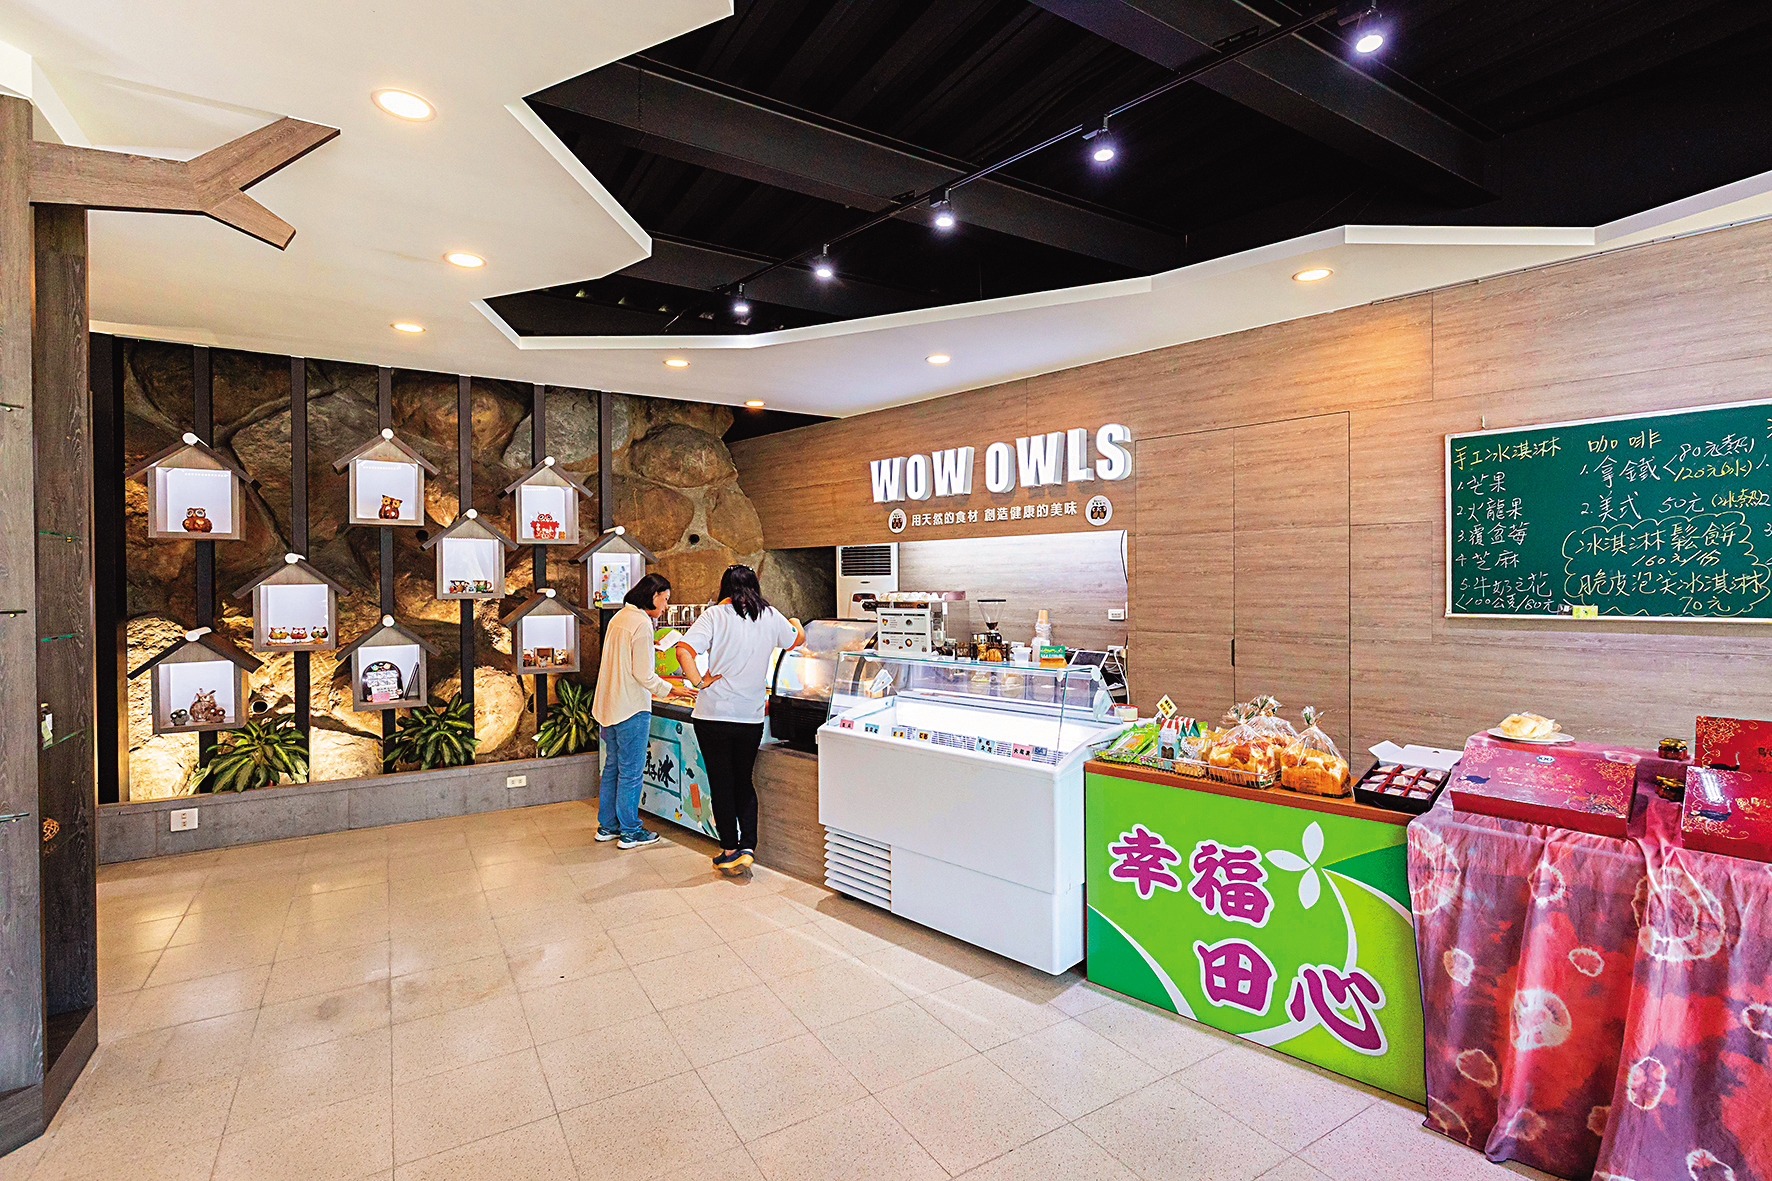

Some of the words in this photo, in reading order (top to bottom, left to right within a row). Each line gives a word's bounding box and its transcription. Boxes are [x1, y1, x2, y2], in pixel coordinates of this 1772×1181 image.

[870, 446, 974, 503] WOW
[985, 423, 1132, 493] OWLS
[1454, 436, 1561, 470] 手工冰淇淋
[911, 510, 978, 527] 用天然的食材
[984, 501, 1077, 522] 創造健康的美味
[1108, 824, 1274, 927] 幸福
[1193, 938, 1387, 1055] 田心
